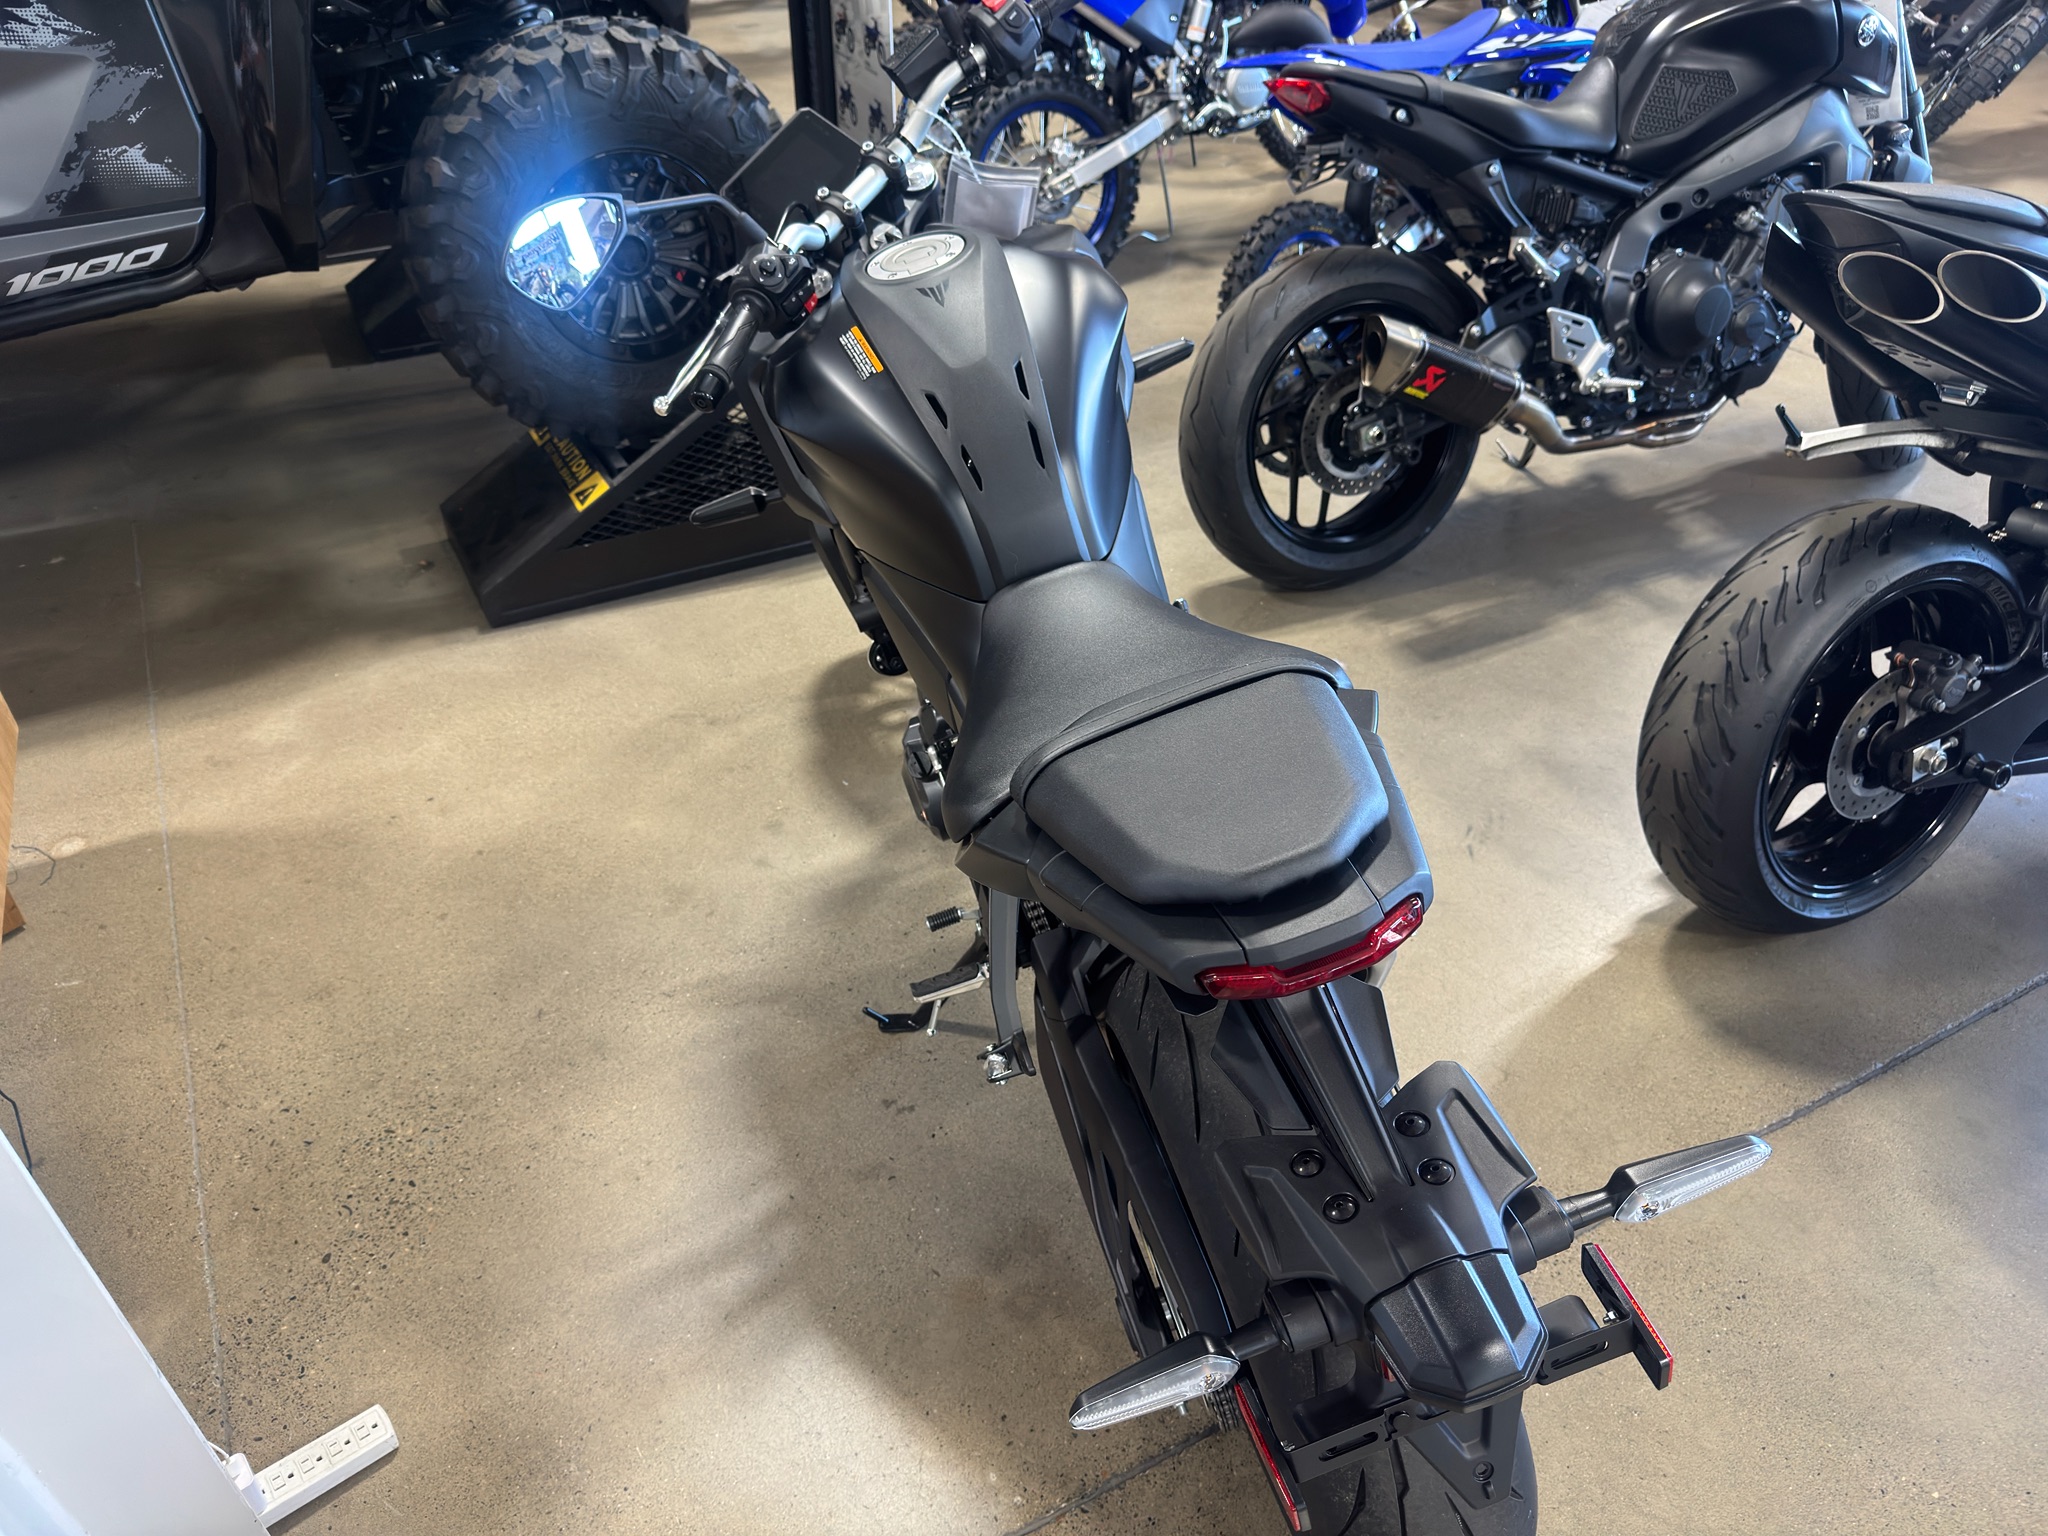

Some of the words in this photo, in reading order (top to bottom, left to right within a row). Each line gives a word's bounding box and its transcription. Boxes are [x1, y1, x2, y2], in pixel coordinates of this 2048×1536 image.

[6, 243, 168, 296] 1000
[553, 436, 592, 481] AUTION
[1991, 586, 2021, 655] MICEL
